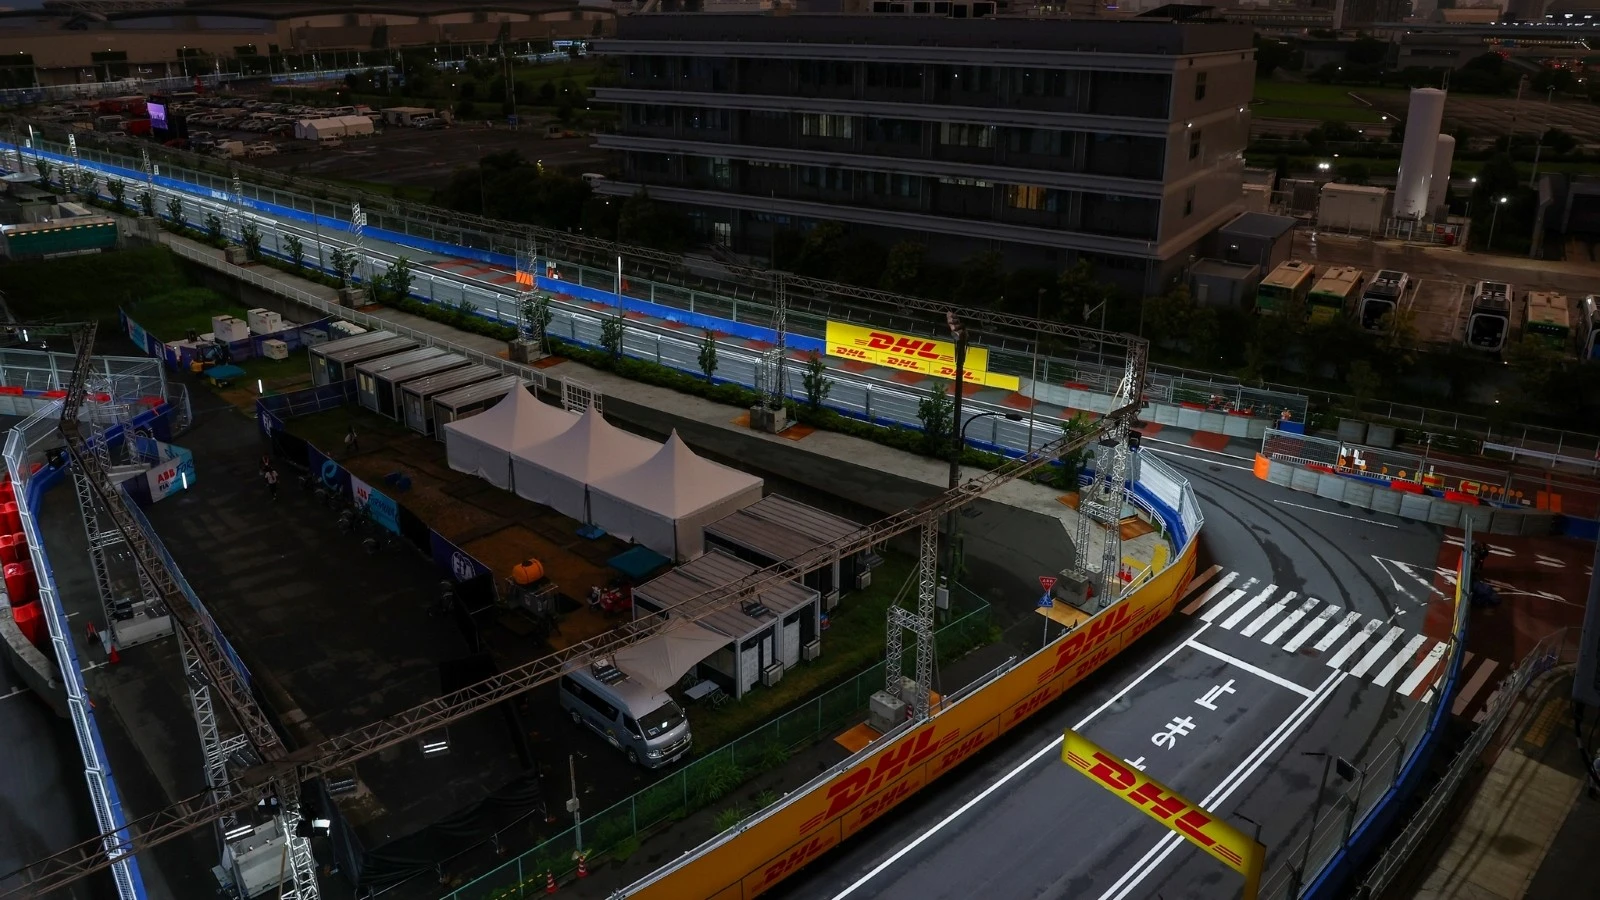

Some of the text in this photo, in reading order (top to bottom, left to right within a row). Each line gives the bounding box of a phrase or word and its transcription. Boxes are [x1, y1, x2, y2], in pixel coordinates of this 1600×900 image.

[836, 346, 866, 359] DHL
[867, 332, 939, 360] DHL
[887, 356, 919, 369] DHL
[158, 469, 175, 484] ABB
[1053, 602, 1131, 674] DHL
[1132, 609, 1161, 637] DHL
[1076, 647, 1110, 678] DHL
[1013, 687, 1054, 721] DHL
[1124, 678, 1237, 772] 止ま
[941, 731, 987, 769] DHL
[823, 725, 941, 820] DHL
[859, 780, 911, 823] DHL
[1088, 752, 1217, 847] DHL
[764, 837, 824, 883] DHL
